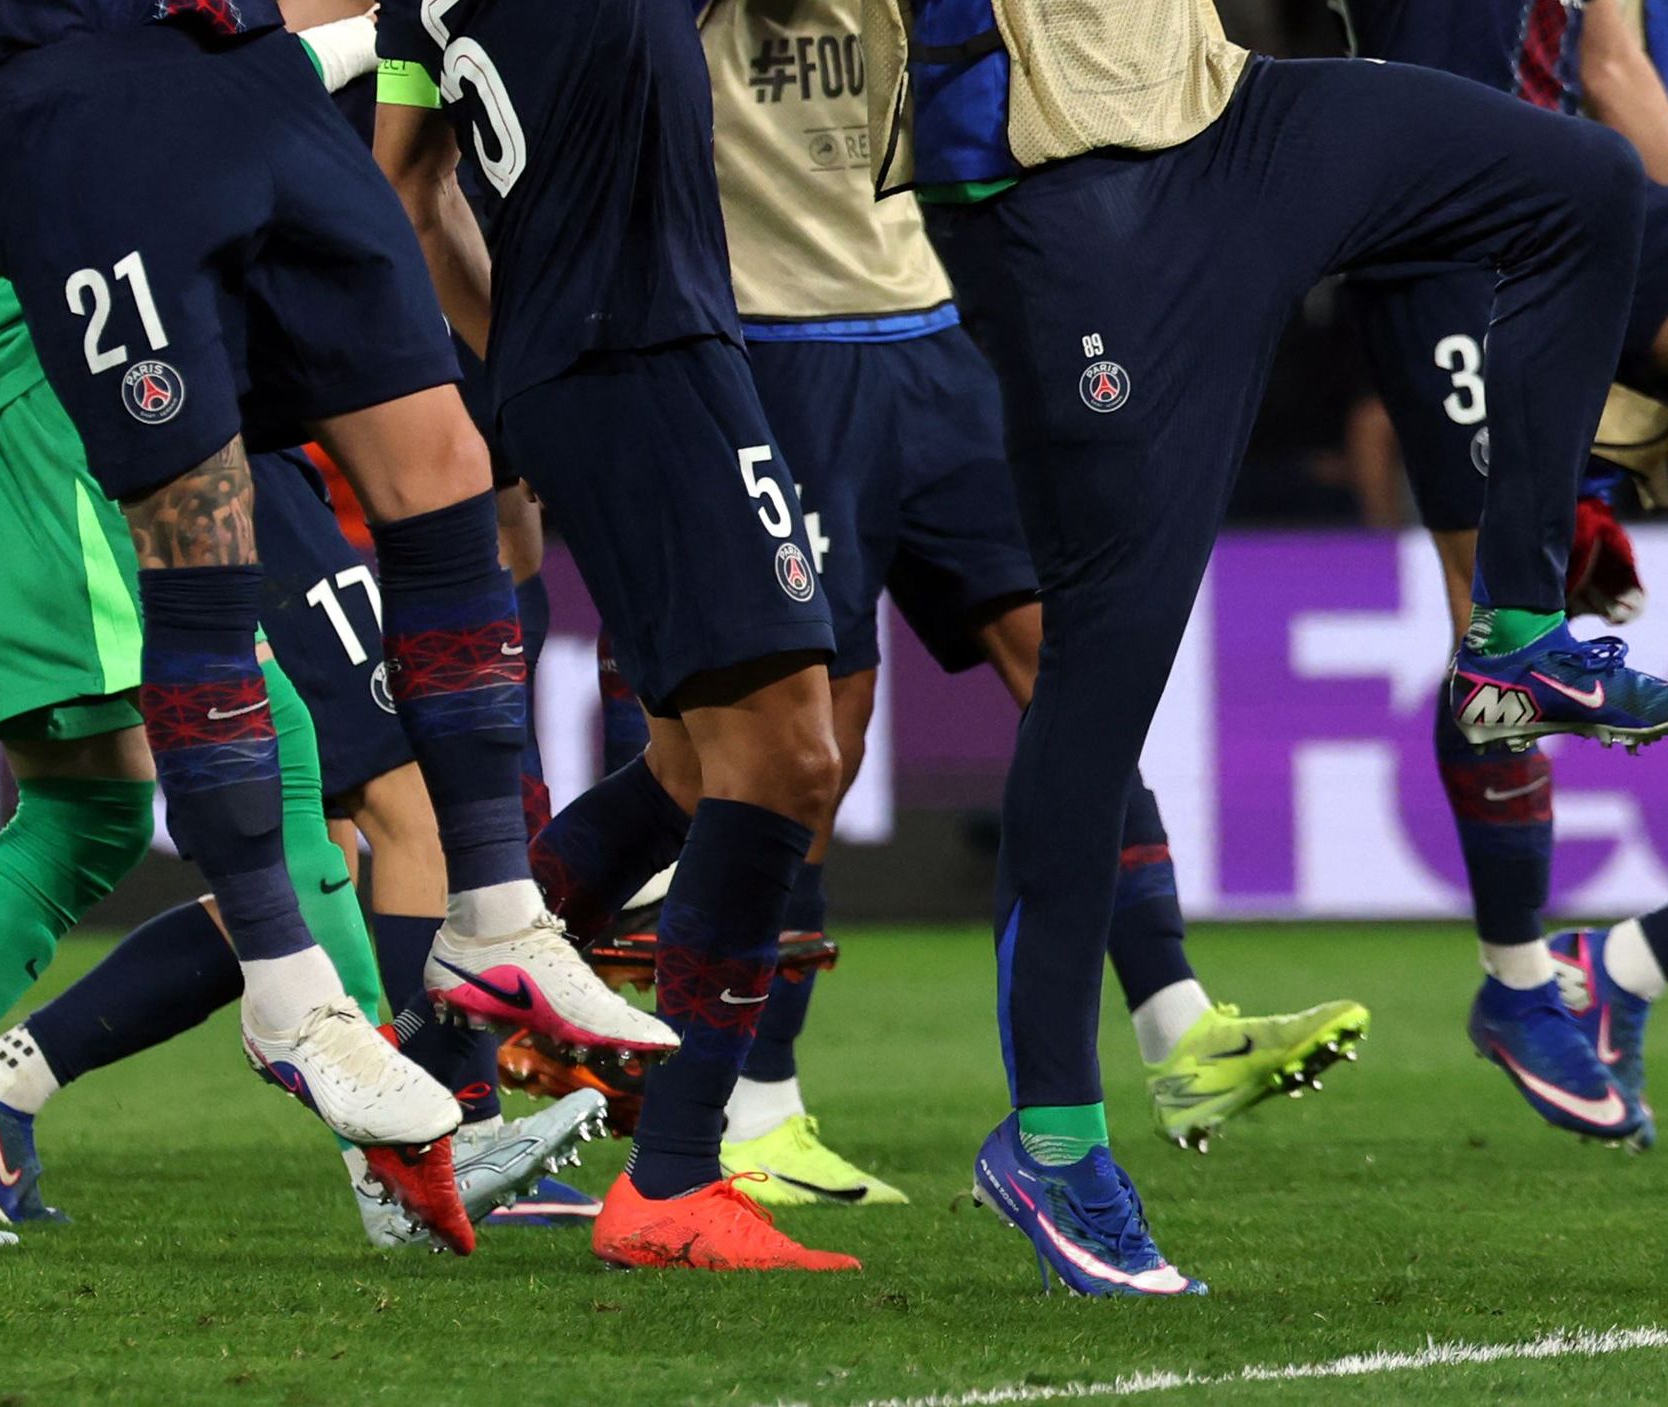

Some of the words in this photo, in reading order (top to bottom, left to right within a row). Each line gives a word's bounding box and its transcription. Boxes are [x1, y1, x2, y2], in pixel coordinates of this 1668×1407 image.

[65, 250, 169, 375] 21
[1081, 332, 1105, 359] 89
[126, 364, 164, 386] PARIS
[1086, 364, 1120, 379] PARIS
[1434, 333, 1489, 426] 3
[737, 444, 793, 539] 5
[305, 564, 383, 667] 17
